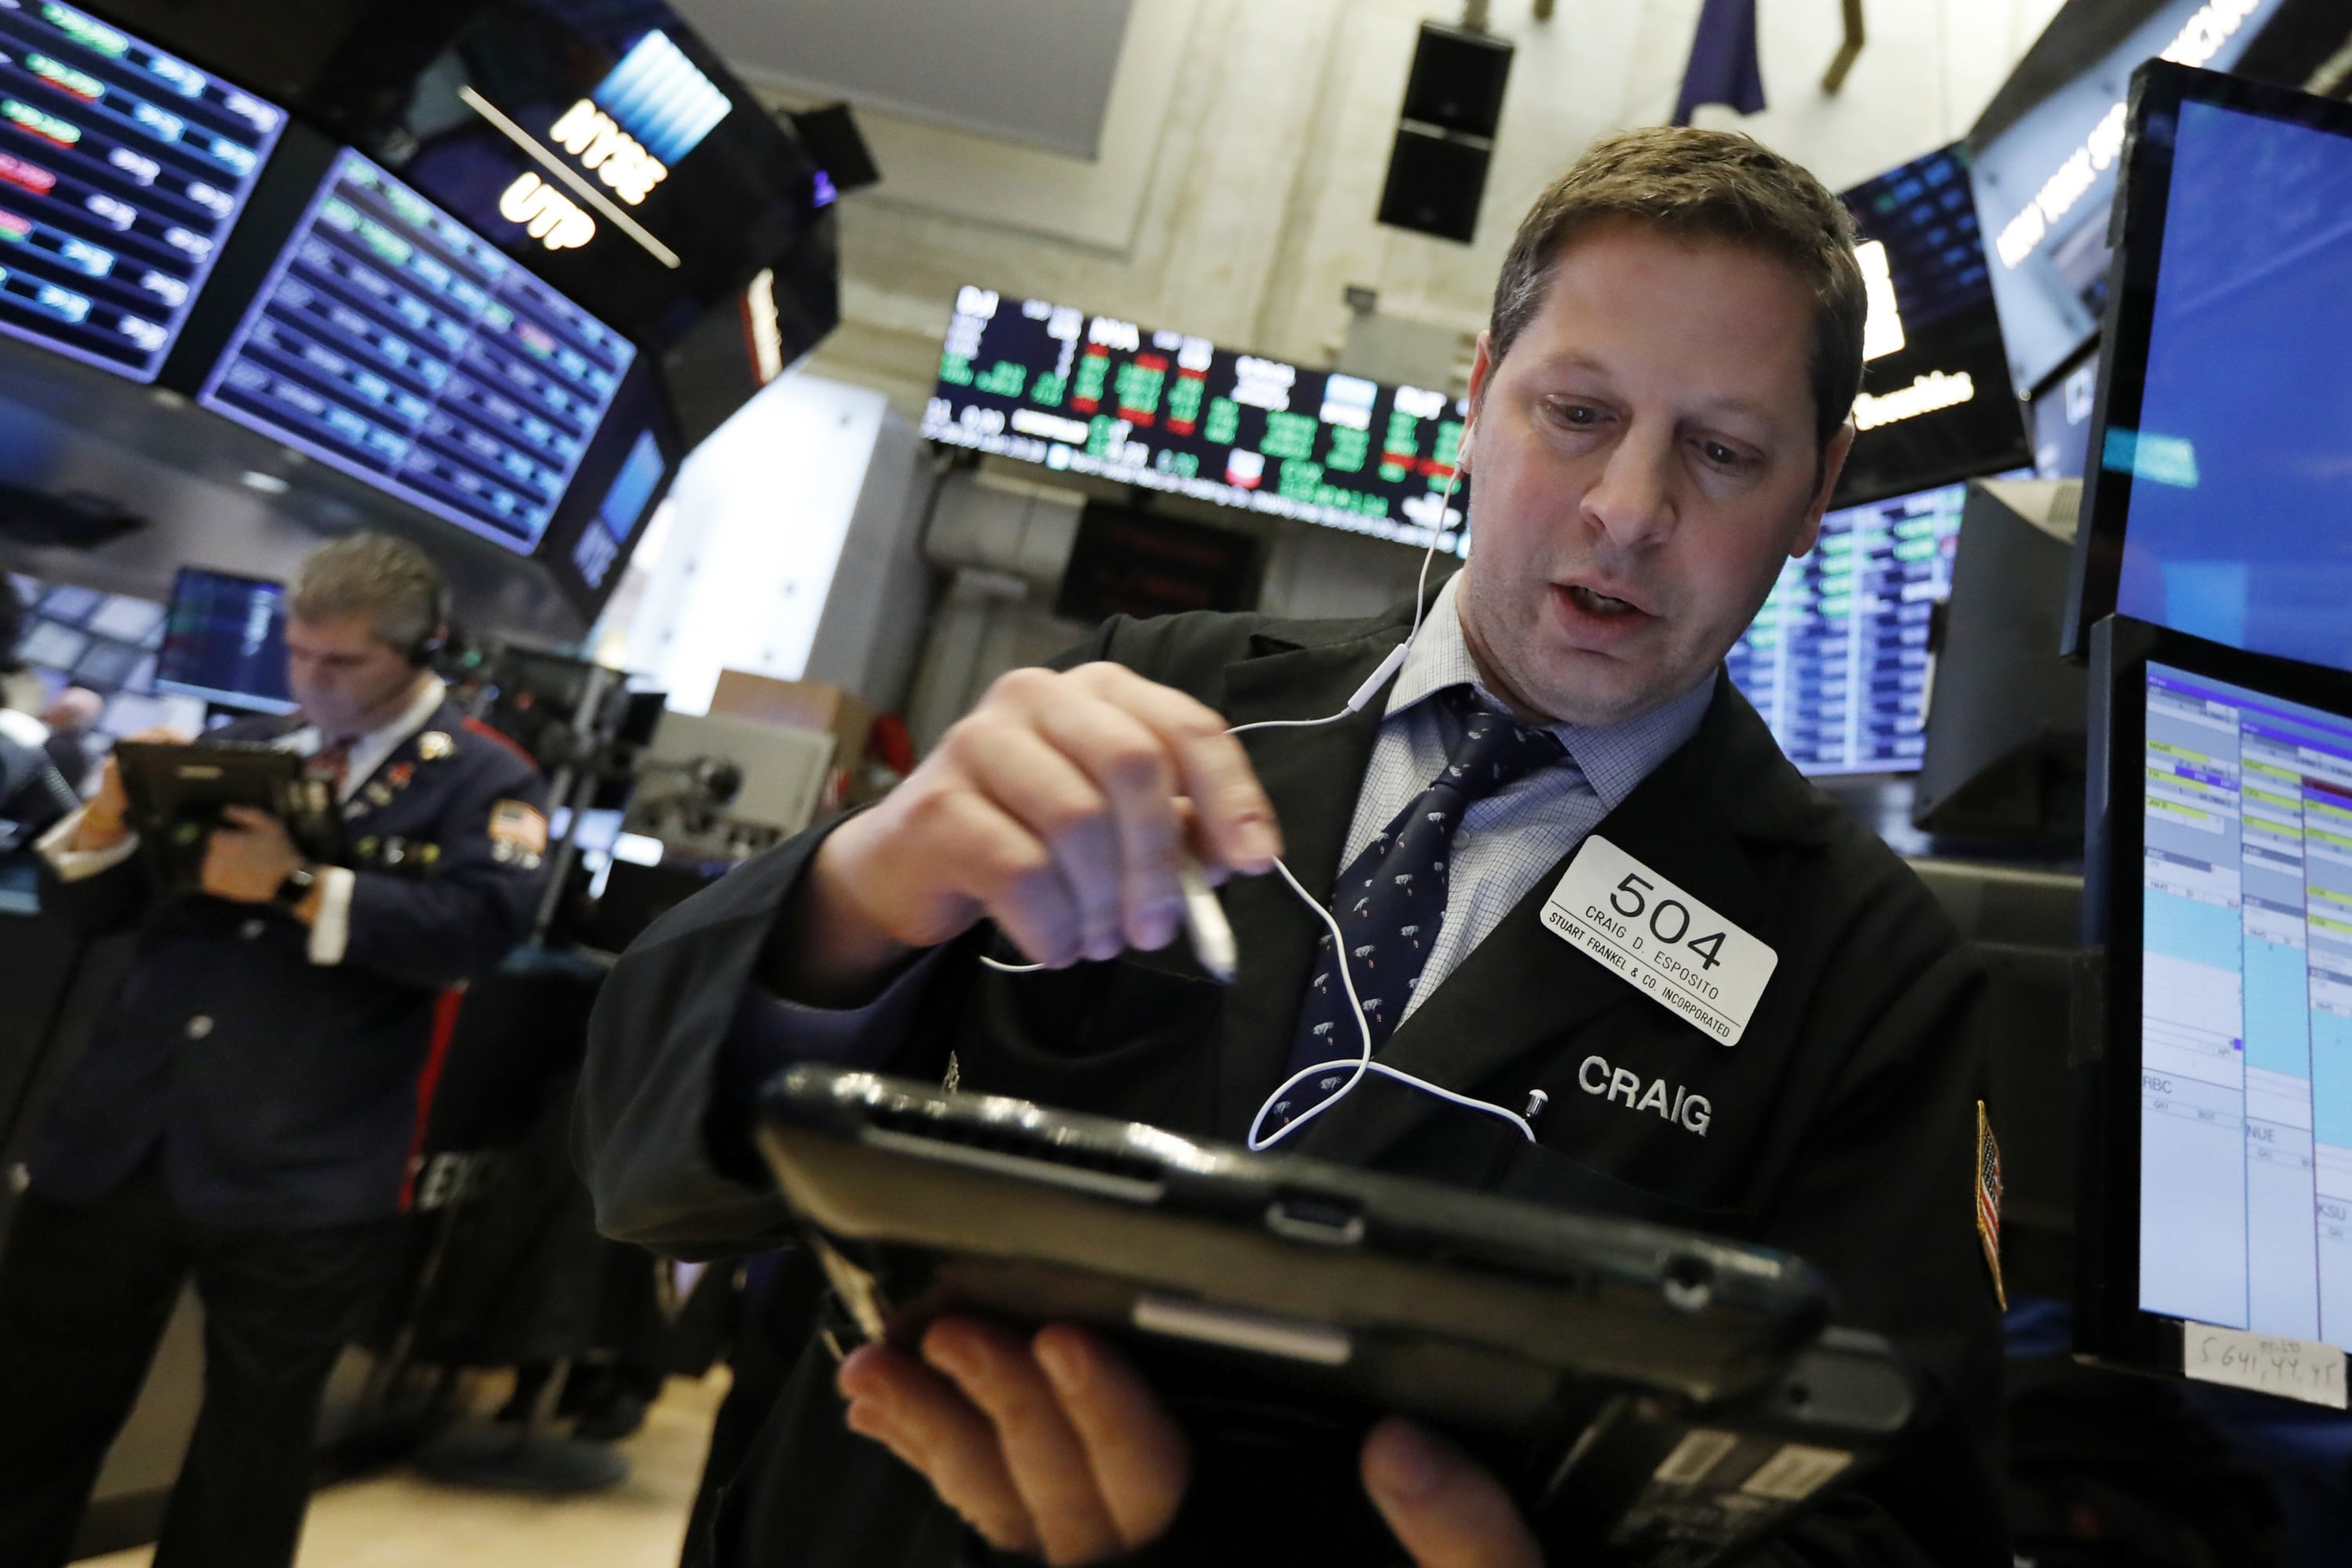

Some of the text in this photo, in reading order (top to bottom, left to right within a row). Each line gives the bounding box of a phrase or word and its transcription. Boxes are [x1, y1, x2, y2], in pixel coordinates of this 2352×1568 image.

[1585, 905, 1719, 1001] CRAIG D. ESPOSITO
[1610, 873, 1727, 971] 504
[1549, 913, 1585, 941] STUART
[1587, 937, 1626, 971] FRANKEL
[1630, 967, 1639, 978] &
[1661, 987, 1730, 1039] INCORPORATED
[1578, 1055, 1712, 1137] CRAIG
[2143, 1075, 2172, 1094] RBC
